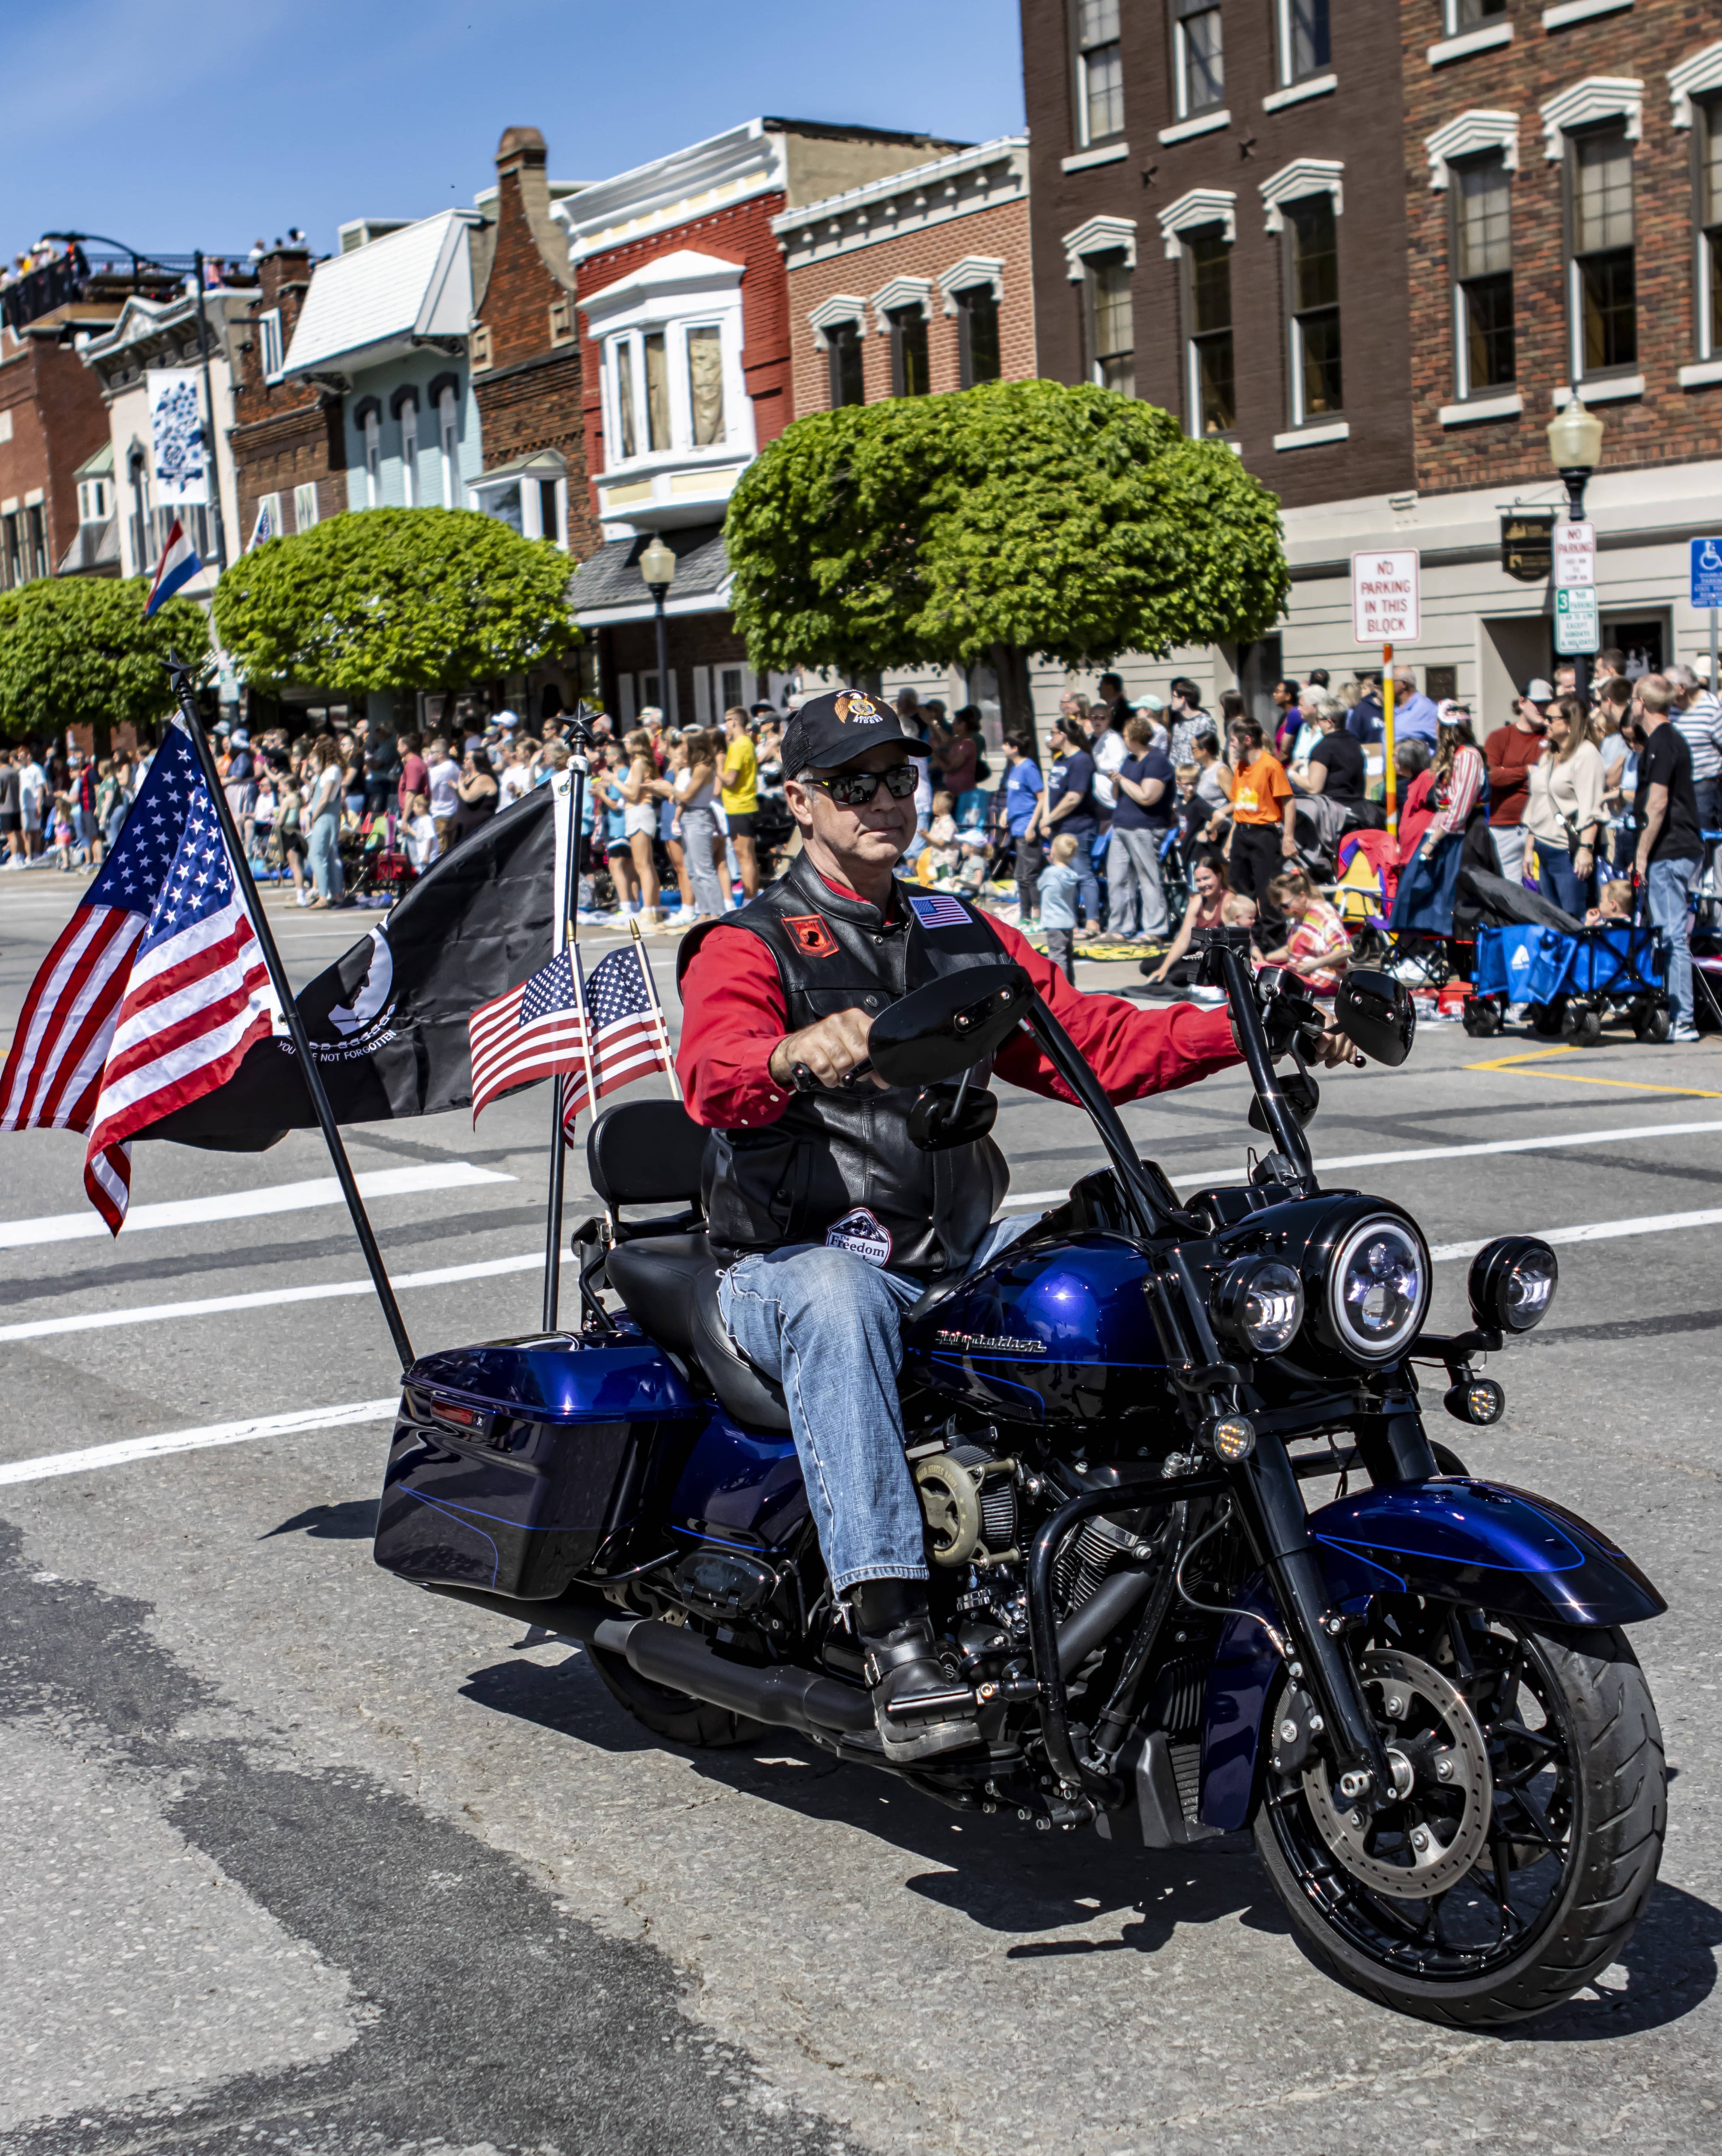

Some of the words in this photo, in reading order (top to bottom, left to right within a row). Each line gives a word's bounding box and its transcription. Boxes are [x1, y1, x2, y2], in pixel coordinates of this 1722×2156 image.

[1567, 528, 1582, 539] NO
[1558, 542, 1592, 553] PARKING
[1377, 561, 1394, 575] NO
[1361, 580, 1411, 594] PARKING
[1365, 600, 1376, 613] IN
[1382, 598, 1407, 612] THIS
[1559, 594, 1567, 609] 3
[1367, 618, 1405, 632] BLOCK
[278, 1041, 296, 1054] YOU
[321, 1053, 340, 1062] NOT
[344, 1030, 397, 1060] FORGOTTEN
[830, 1234, 885, 1257] Freedom
[928, 1465, 944, 1476] STATES
[944, 1470, 958, 1487] ARMY
